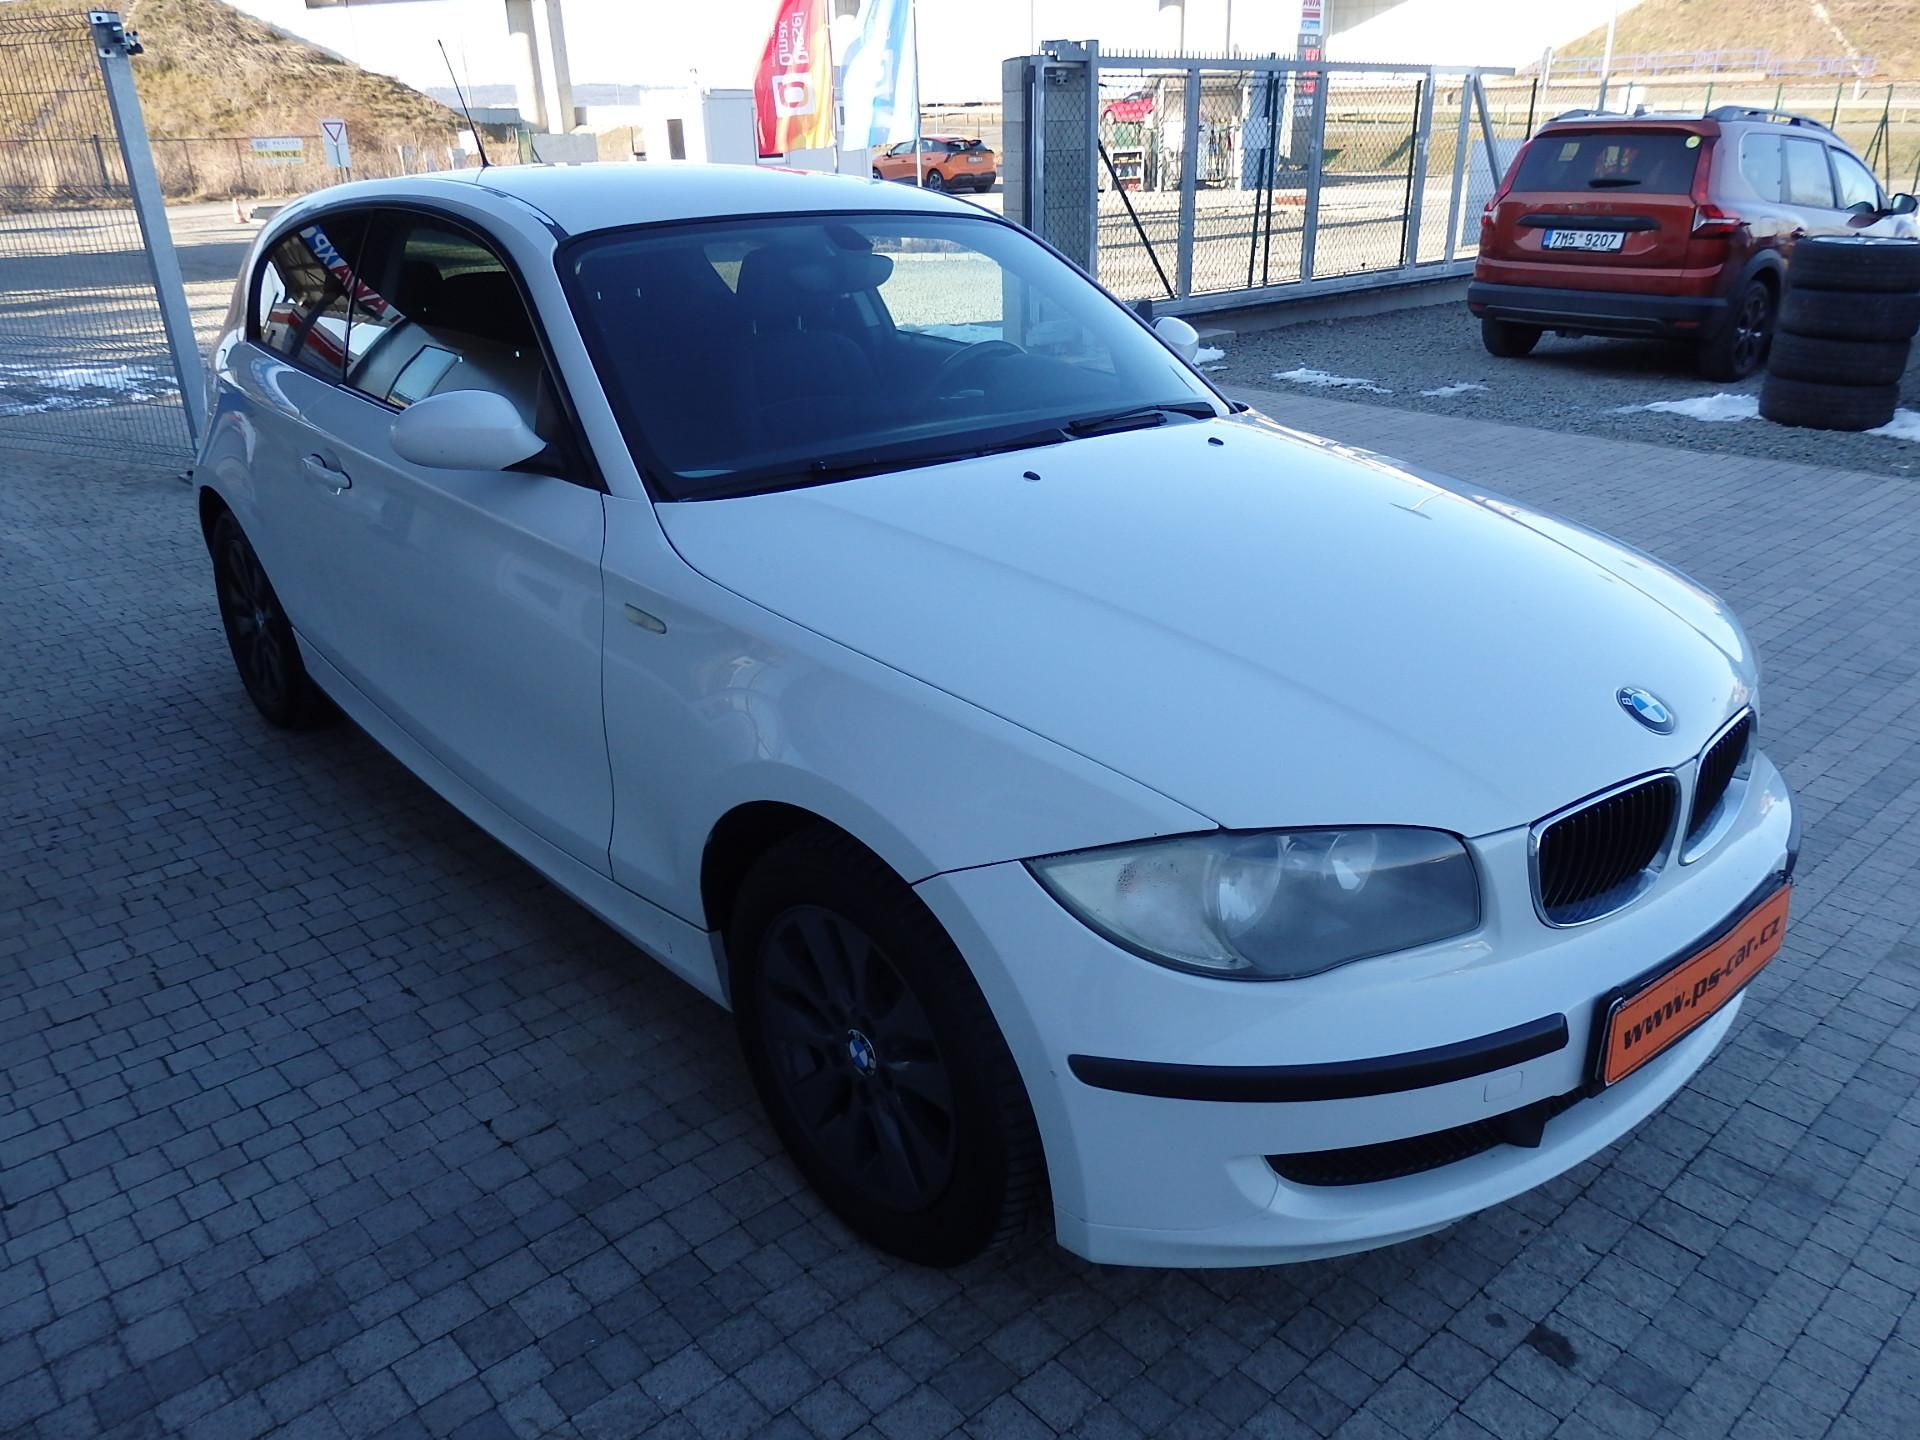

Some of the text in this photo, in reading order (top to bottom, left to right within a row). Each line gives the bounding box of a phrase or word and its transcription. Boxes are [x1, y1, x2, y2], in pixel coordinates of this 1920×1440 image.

[1553, 232, 1617, 247] 7M5 9207
[1623, 916, 1781, 1049] www.ps-car.cz
